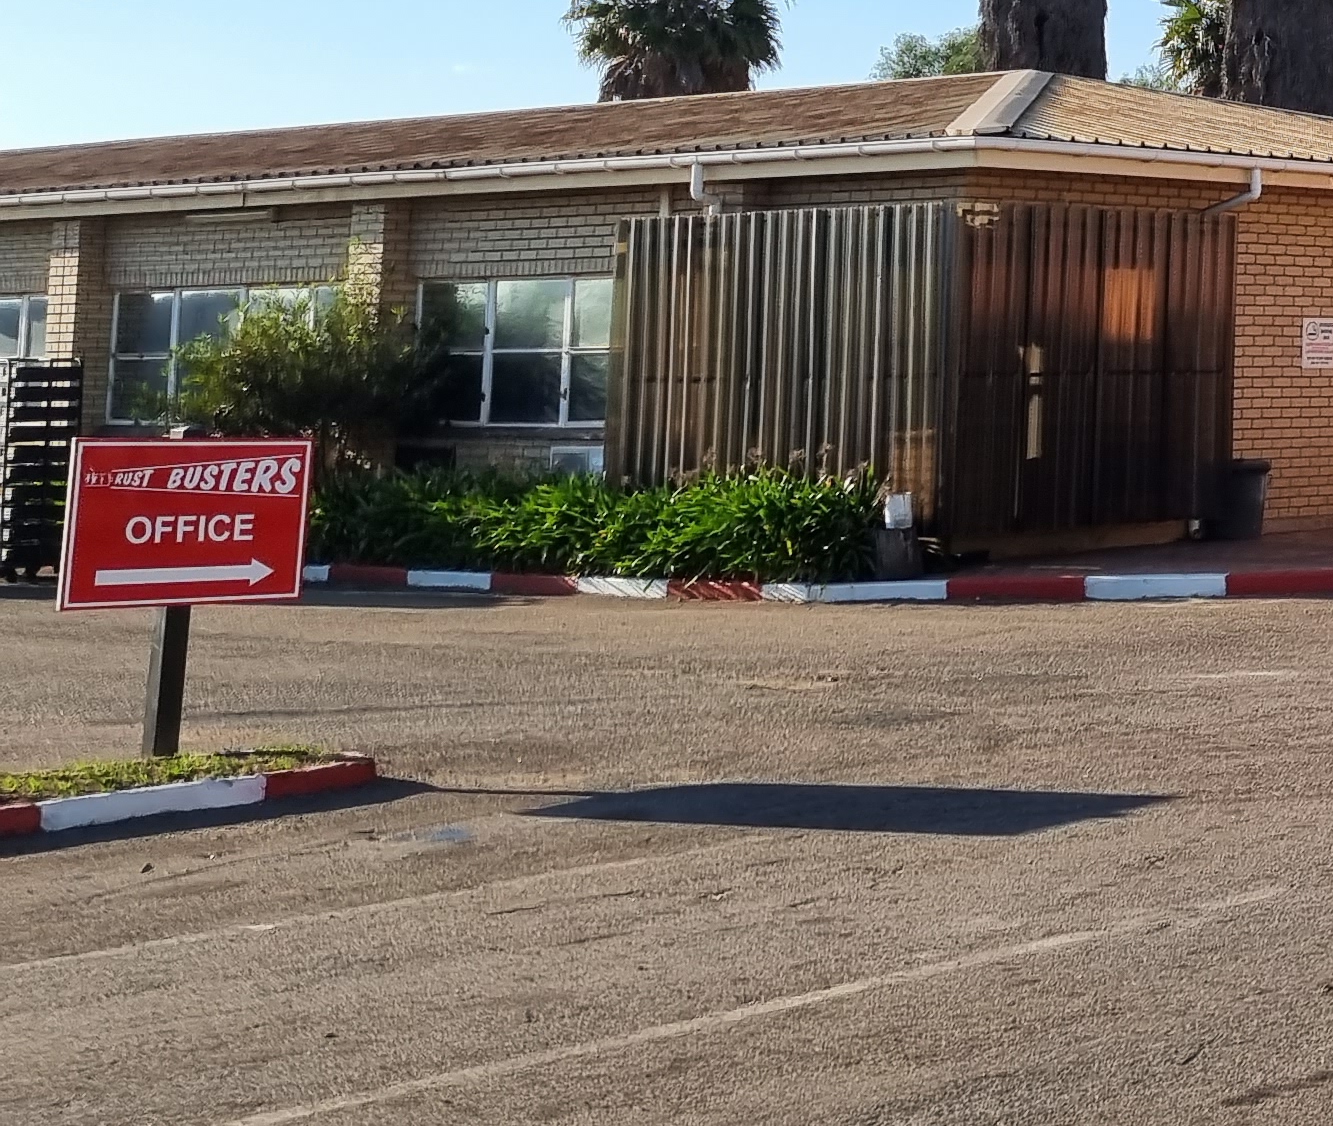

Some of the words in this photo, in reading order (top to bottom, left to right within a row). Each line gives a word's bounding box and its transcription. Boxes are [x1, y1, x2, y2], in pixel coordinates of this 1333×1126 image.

[114, 469, 155, 487] RUST
[166, 458, 301, 494] BUSTERS
[125, 514, 255, 544] OFFICE
